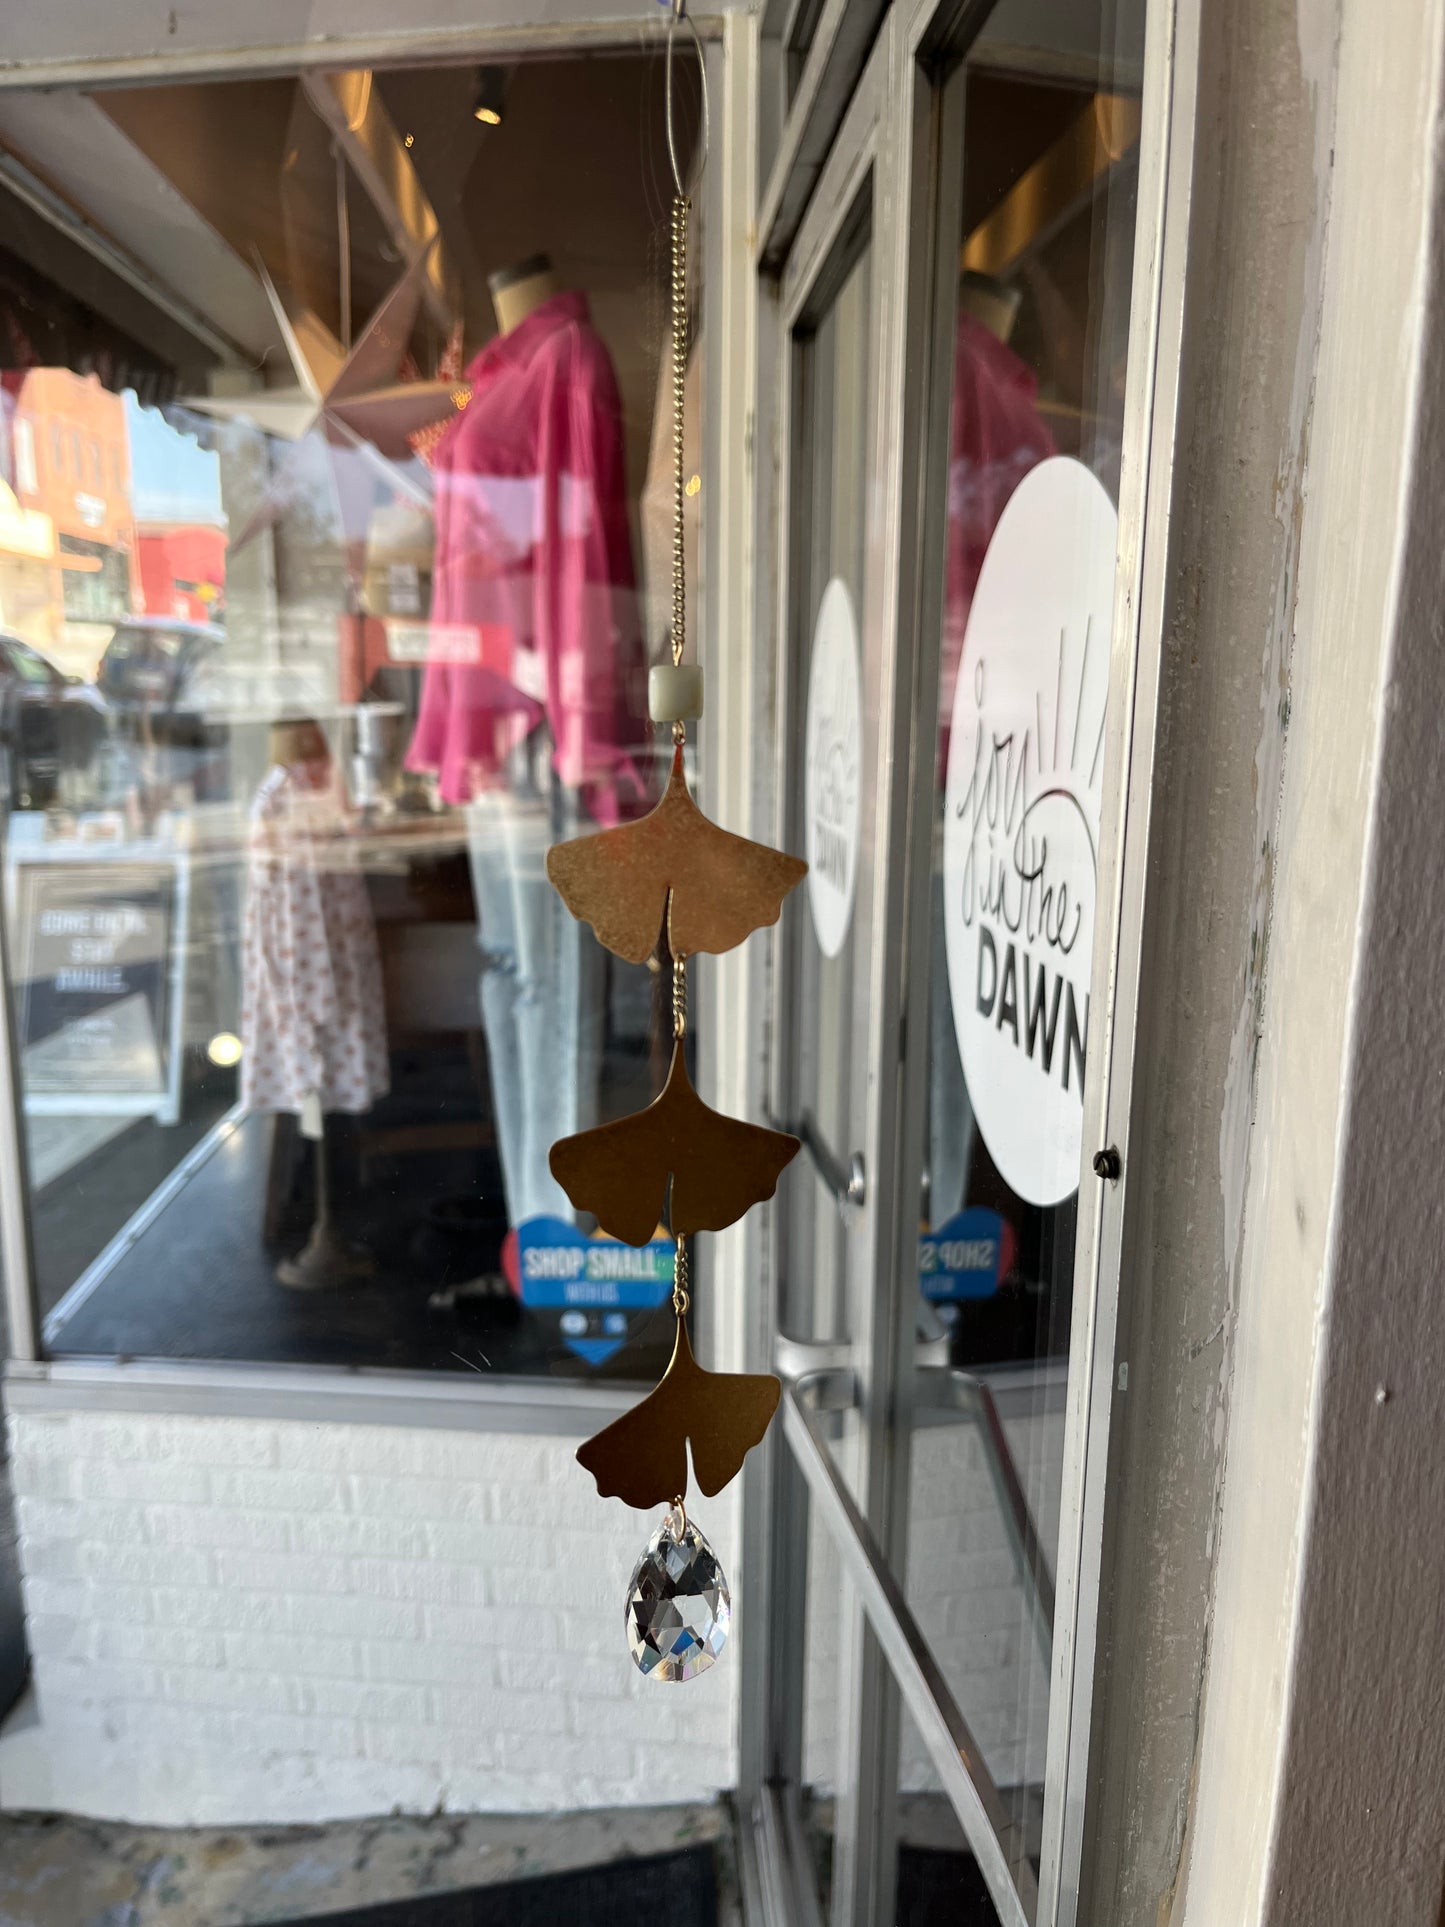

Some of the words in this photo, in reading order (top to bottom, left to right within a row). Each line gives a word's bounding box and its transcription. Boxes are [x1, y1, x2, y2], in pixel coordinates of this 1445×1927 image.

[957, 657, 1030, 931] joy
[976, 923, 1090, 1107] DAWN
[524, 1247, 583, 1280] SHOP
[586, 1247, 657, 1280] SMALL
